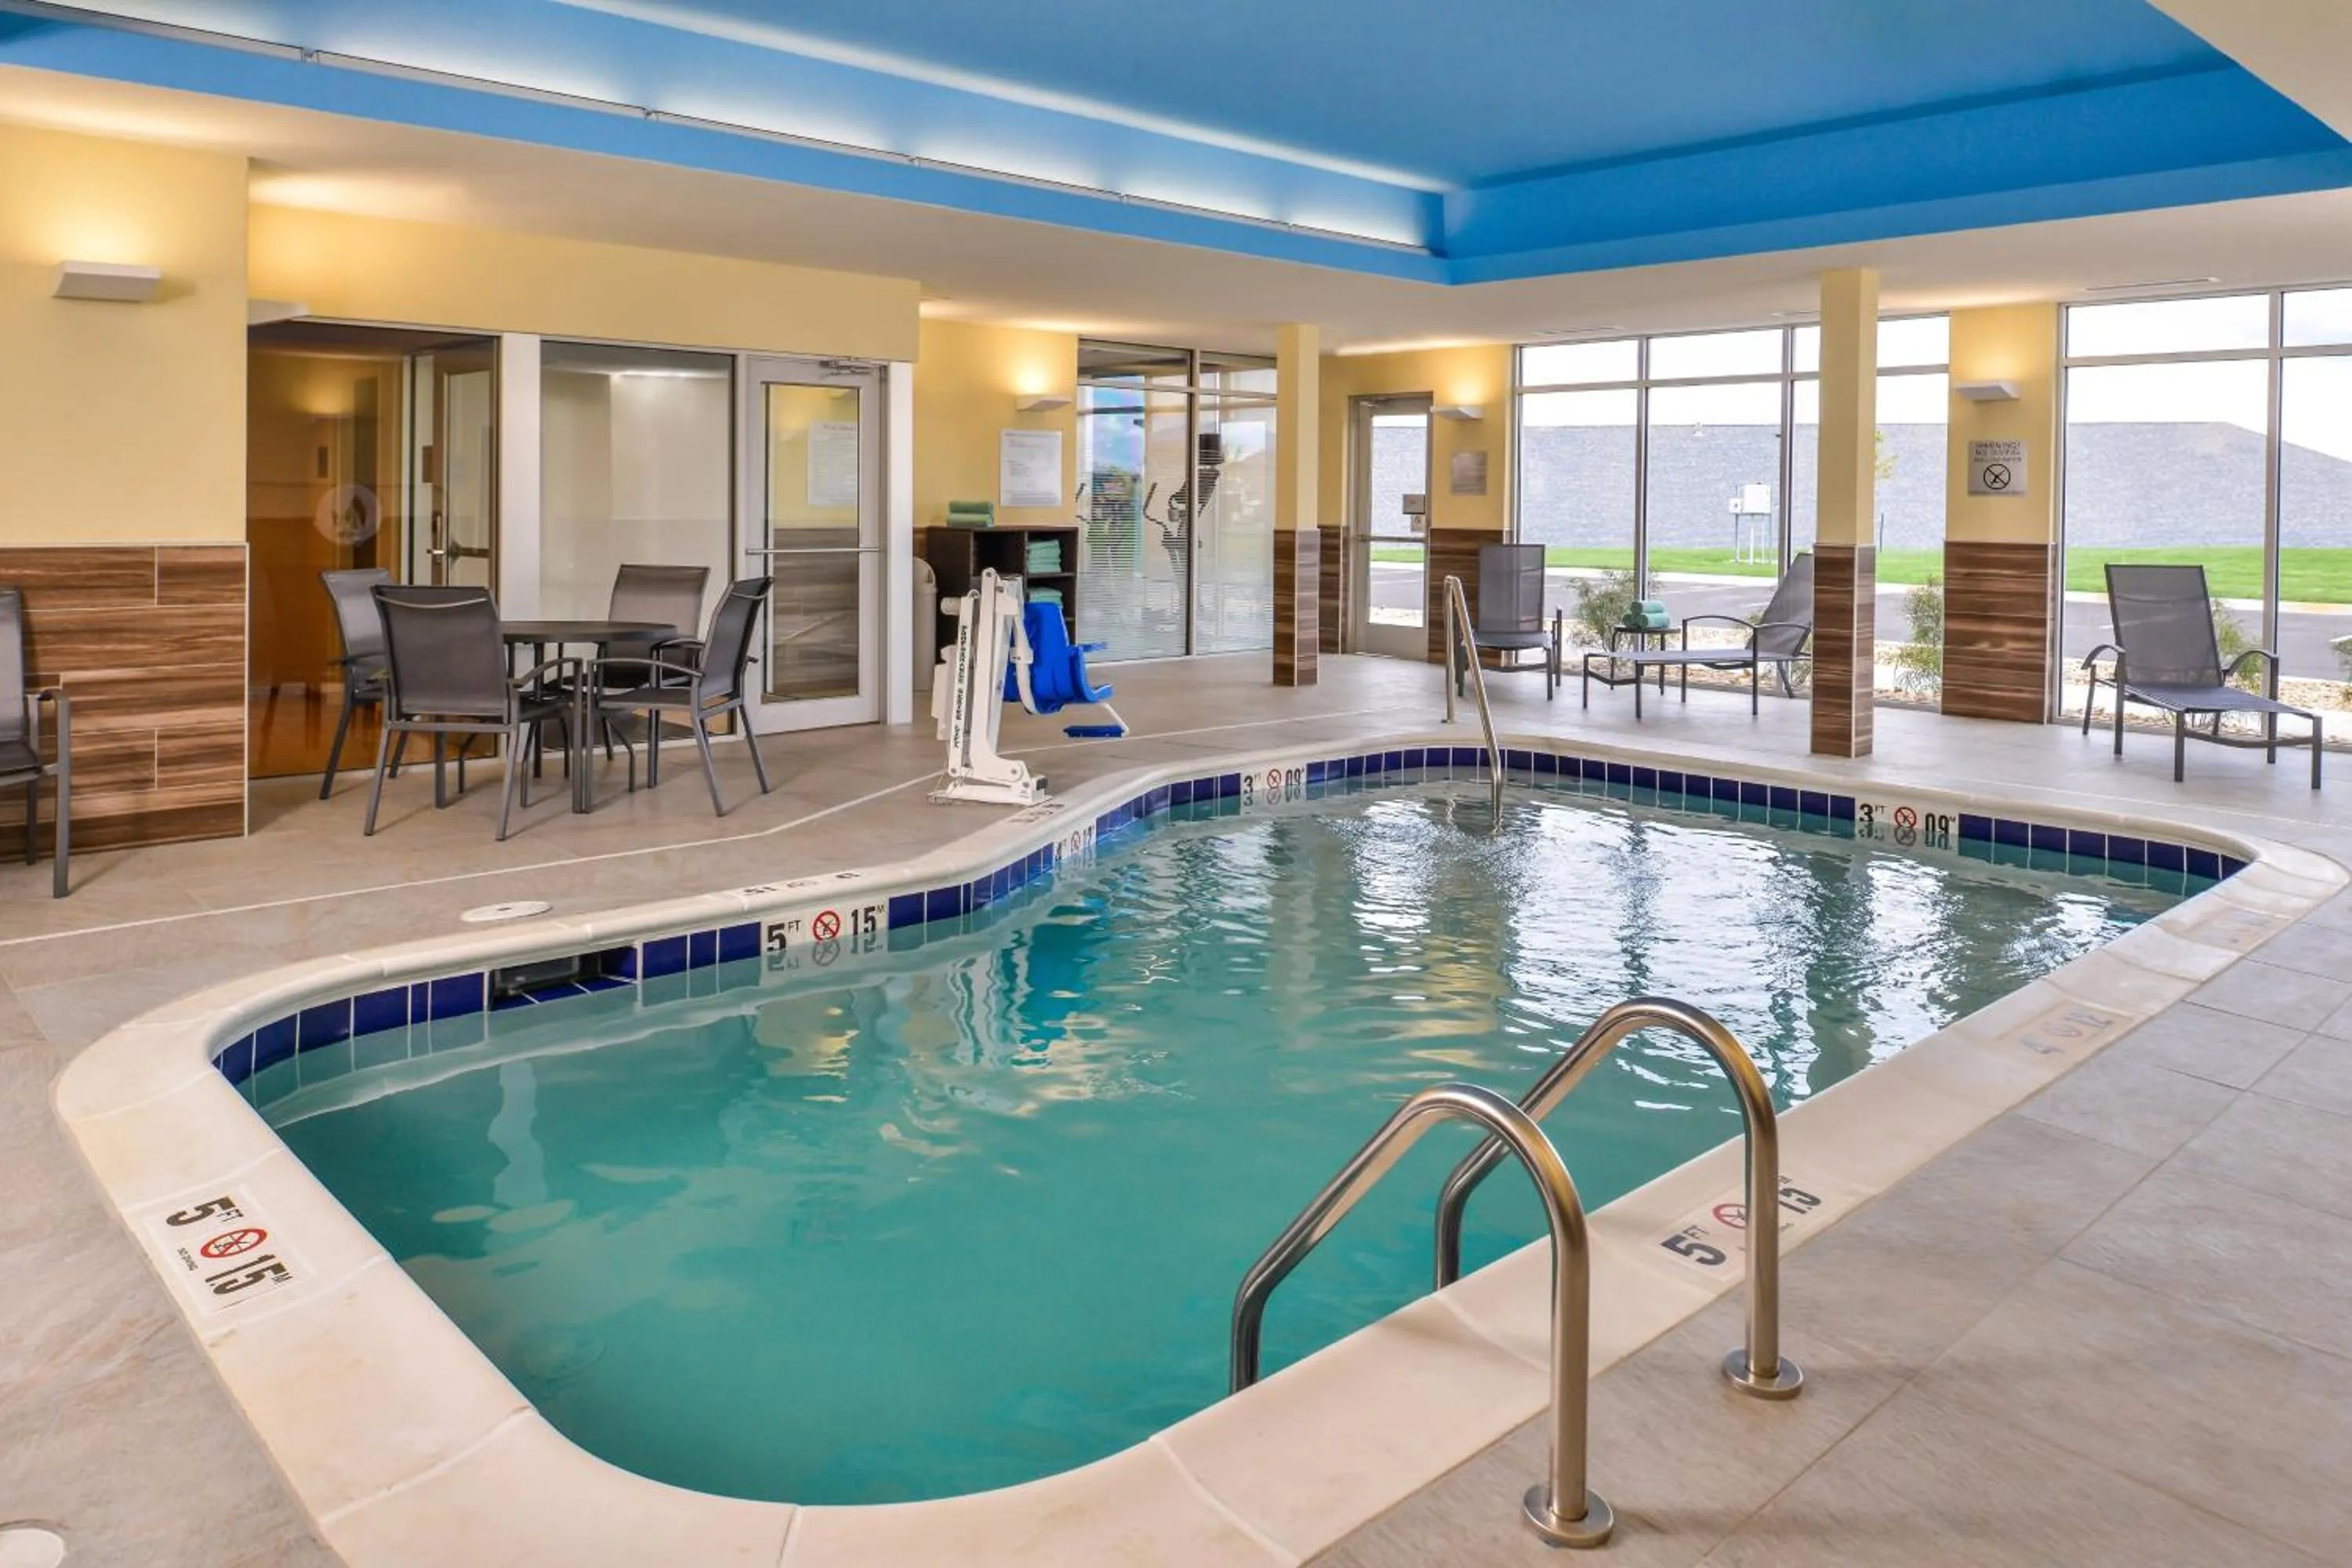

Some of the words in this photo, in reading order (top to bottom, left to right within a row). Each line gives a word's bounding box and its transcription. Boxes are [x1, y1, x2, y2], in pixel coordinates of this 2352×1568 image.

[1859, 803, 1874, 822] 3
[767, 924, 786, 951] 5
[165, 1196, 236, 1227] 5
[1660, 1232, 1727, 1267] 5
